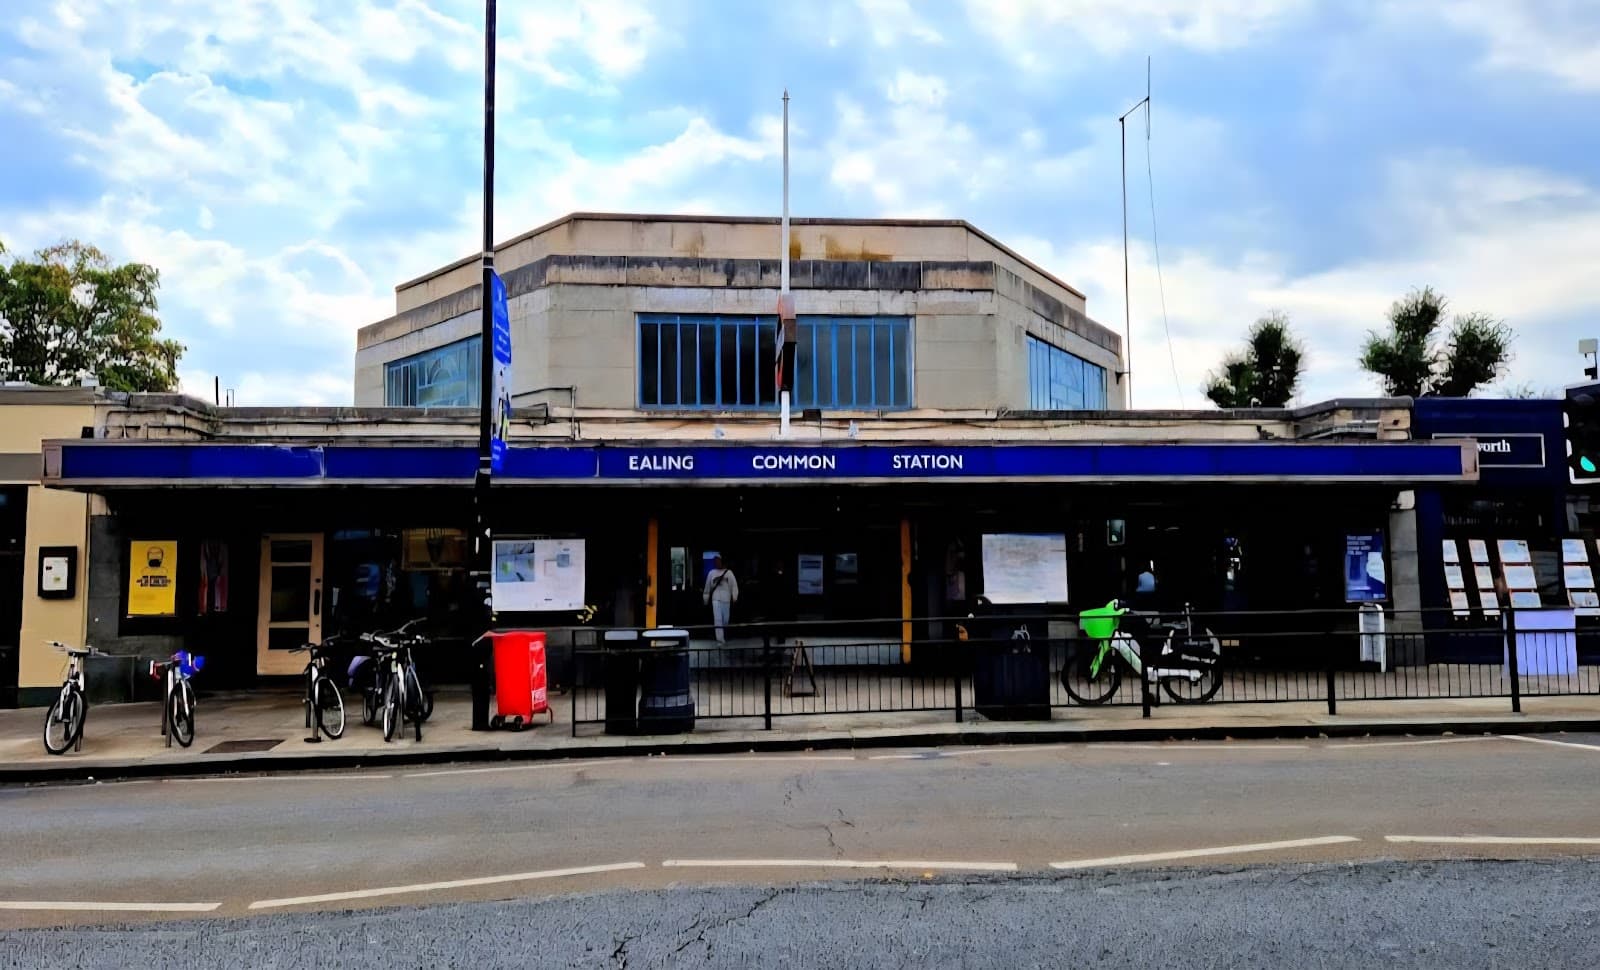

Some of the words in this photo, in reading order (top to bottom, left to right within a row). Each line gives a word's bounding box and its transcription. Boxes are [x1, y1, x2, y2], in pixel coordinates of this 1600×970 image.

[628, 455, 694, 471] EALING
[752, 455, 836, 470] COMMON
[893, 454, 963, 469] STATION
